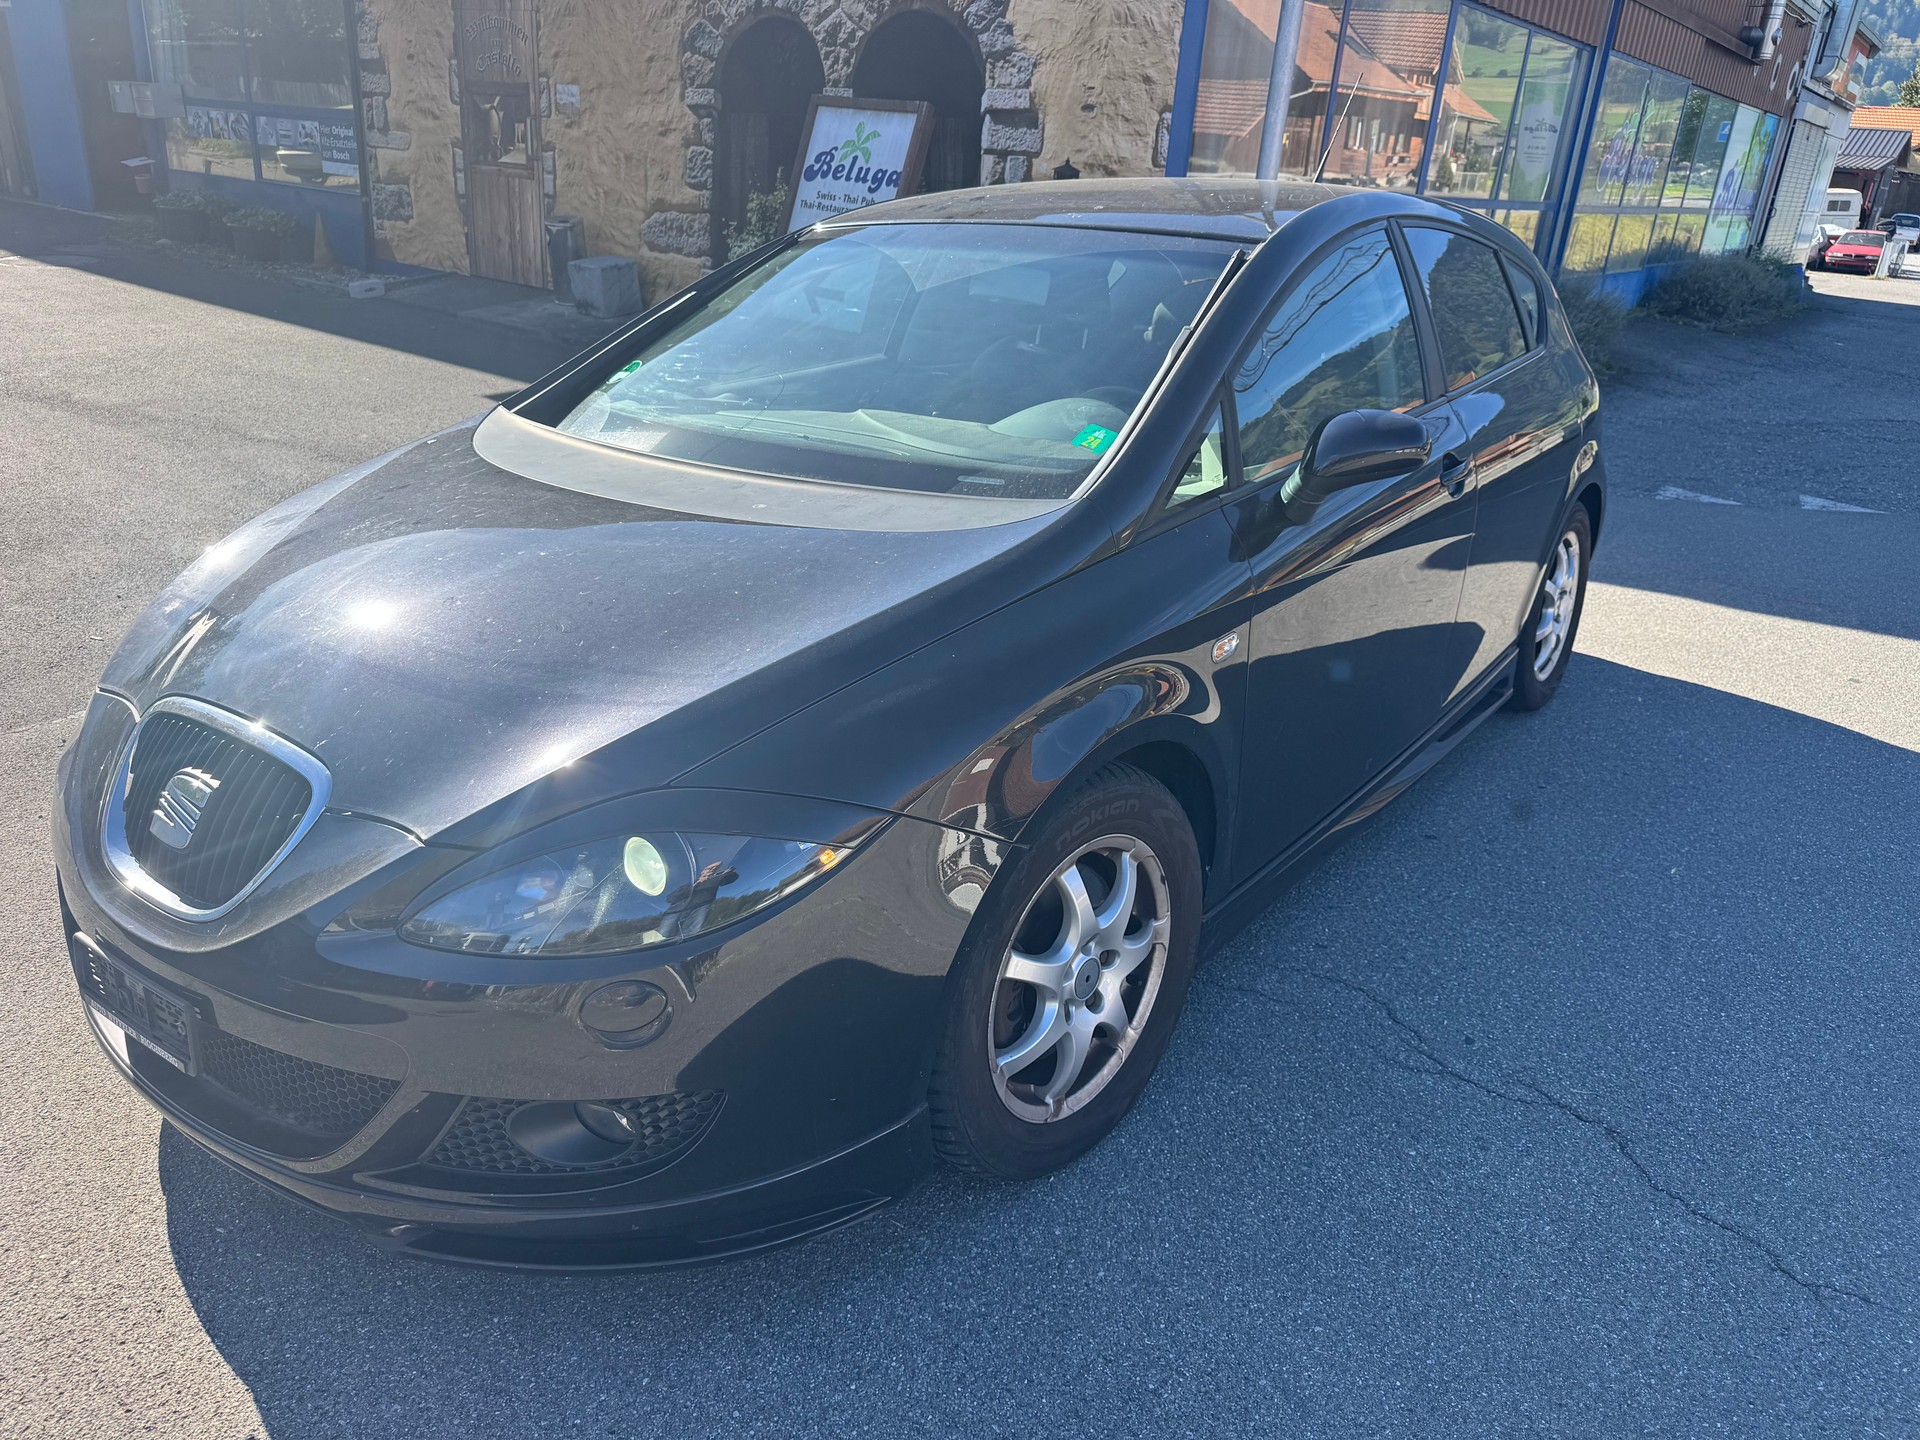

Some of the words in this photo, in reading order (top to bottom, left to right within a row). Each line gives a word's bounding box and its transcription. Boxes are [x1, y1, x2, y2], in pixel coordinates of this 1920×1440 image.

[465, 14, 529, 46] Willkommen
[475, 49, 522, 77] Castello
[332, 126, 353, 137] Original
[322, 137, 357, 149] Kfz-Ersatzteile
[322, 151, 331, 159] von
[333, 150, 350, 160] Bosch
[804, 146, 902, 194] Beluga
[816, 190, 837, 202] Swiss
[843, 194, 860, 205] Thai
[861, 196, 876, 206] Pub
[800, 199, 852, 213] Thai-Restaura
[1081, 435, 1102, 449] 24
